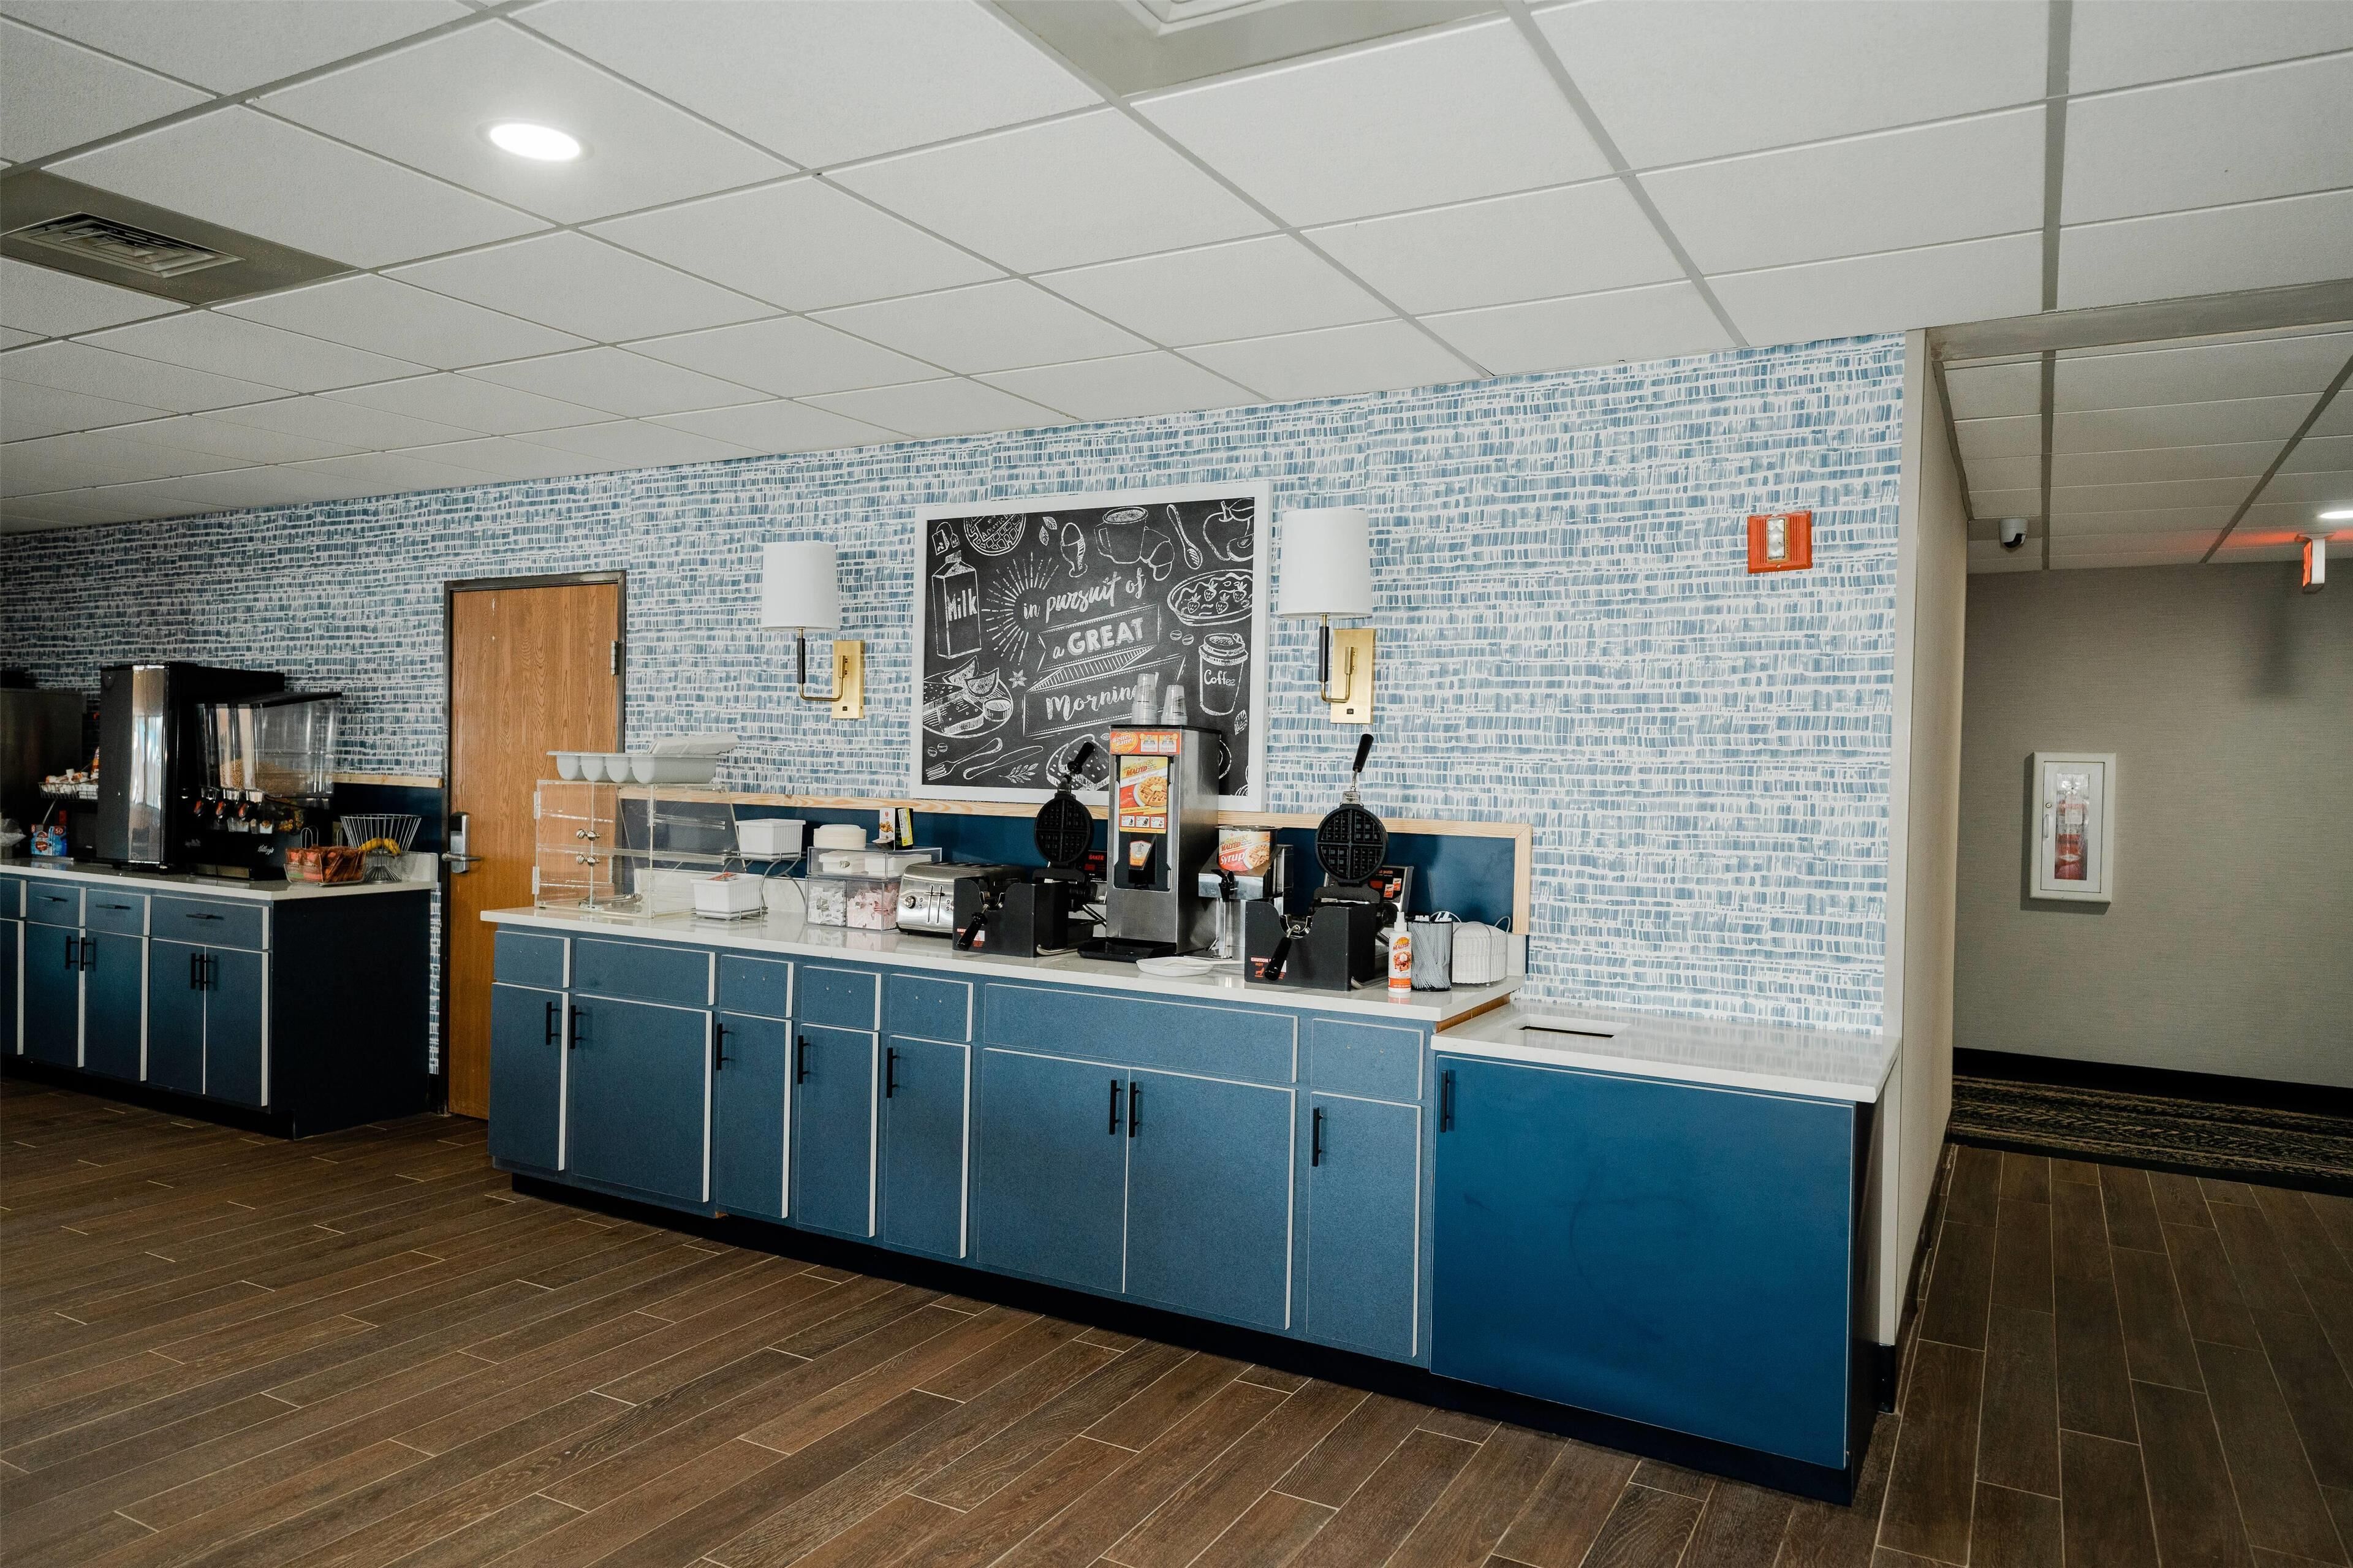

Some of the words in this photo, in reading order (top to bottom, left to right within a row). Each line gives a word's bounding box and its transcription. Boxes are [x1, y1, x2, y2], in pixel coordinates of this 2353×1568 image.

[947, 588, 977, 621] Milk
[1023, 603, 1040, 619] in
[1045, 571, 1121, 623] pursuit
[1126, 567, 1146, 599] of
[1053, 646, 1064, 659] a
[1067, 617, 1143, 656] GREAT
[1203, 669, 1235, 686] Coffee
[1126, 765, 1148, 776] MALTED
[1220, 852, 1246, 865] Syrup
